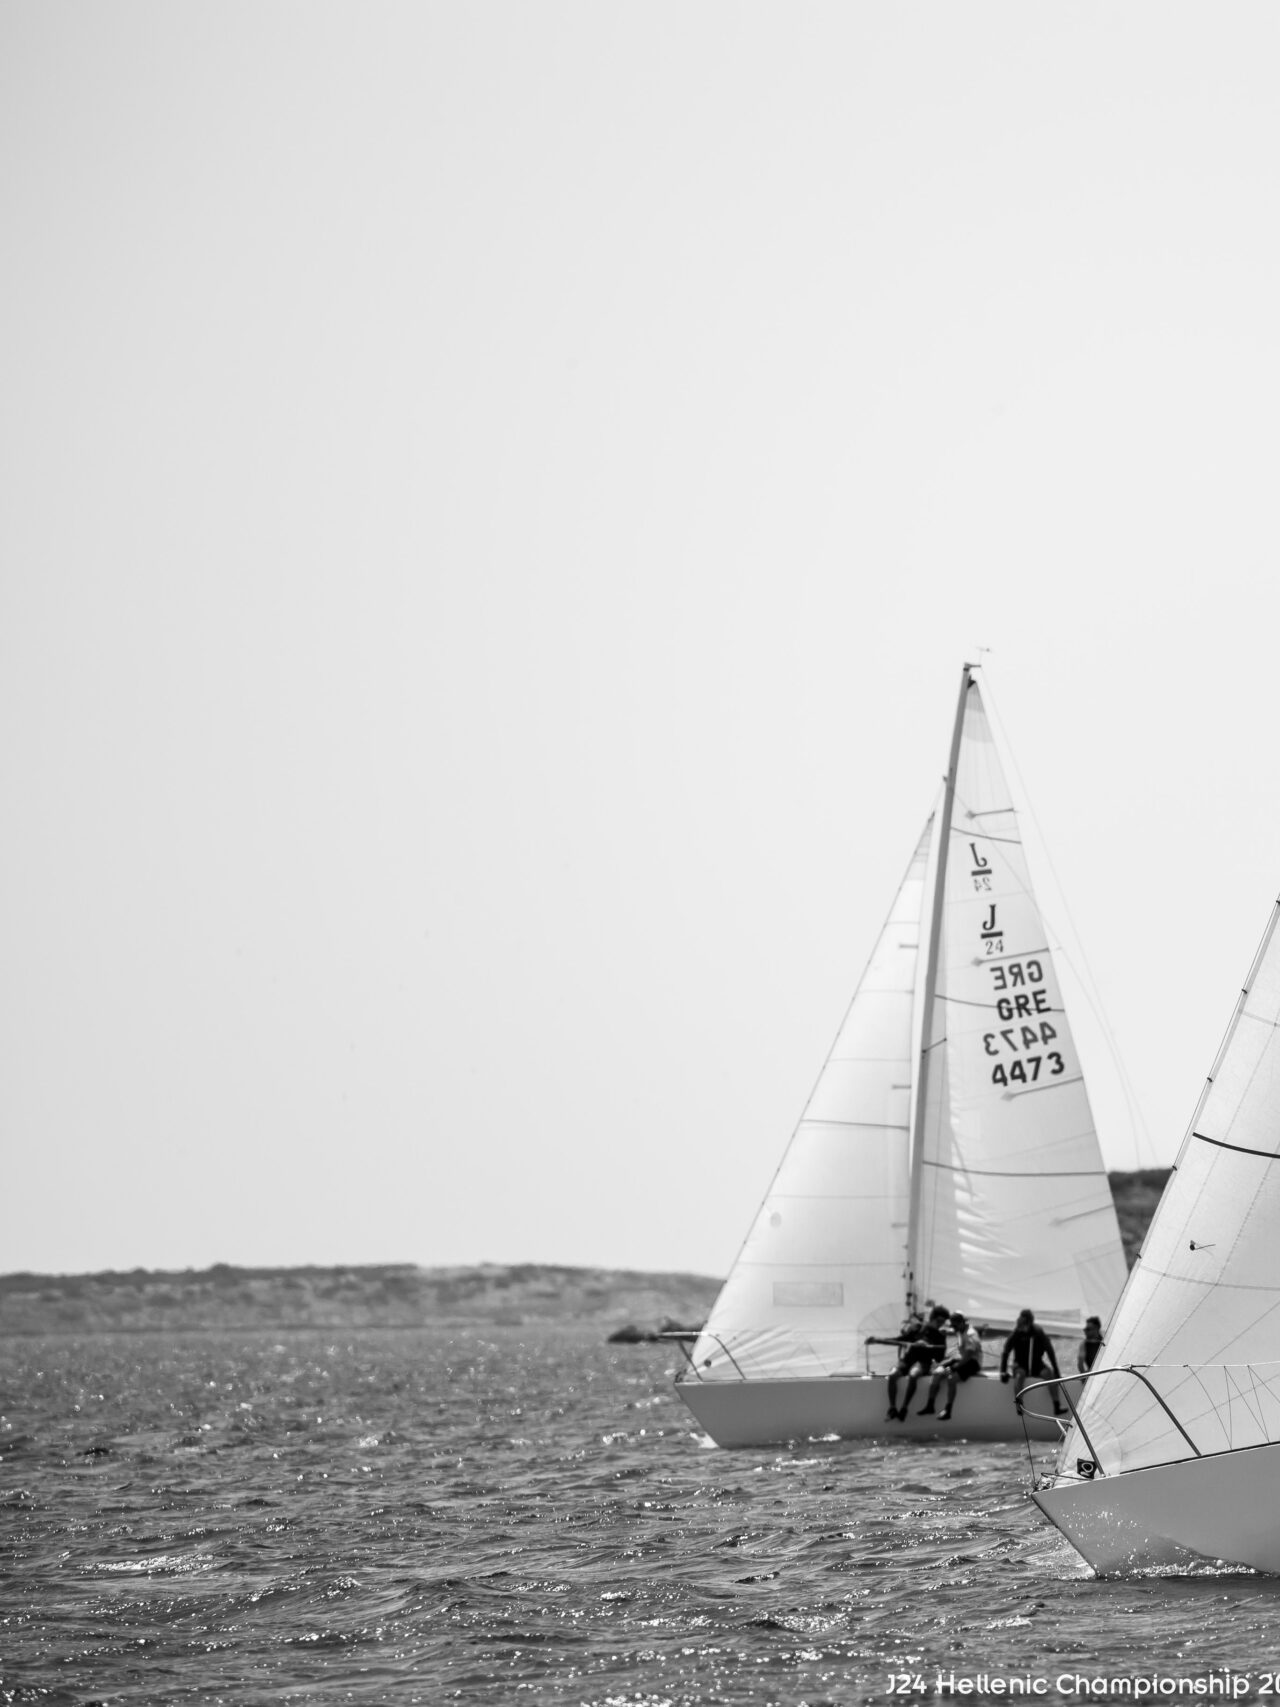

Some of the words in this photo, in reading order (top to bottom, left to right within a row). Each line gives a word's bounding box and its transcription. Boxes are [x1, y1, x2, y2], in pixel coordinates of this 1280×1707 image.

[982, 903, 997, 931] J
[985, 939, 1004, 956] 24
[996, 989, 1052, 1021] GRE
[991, 1051, 1065, 1087] 4473
